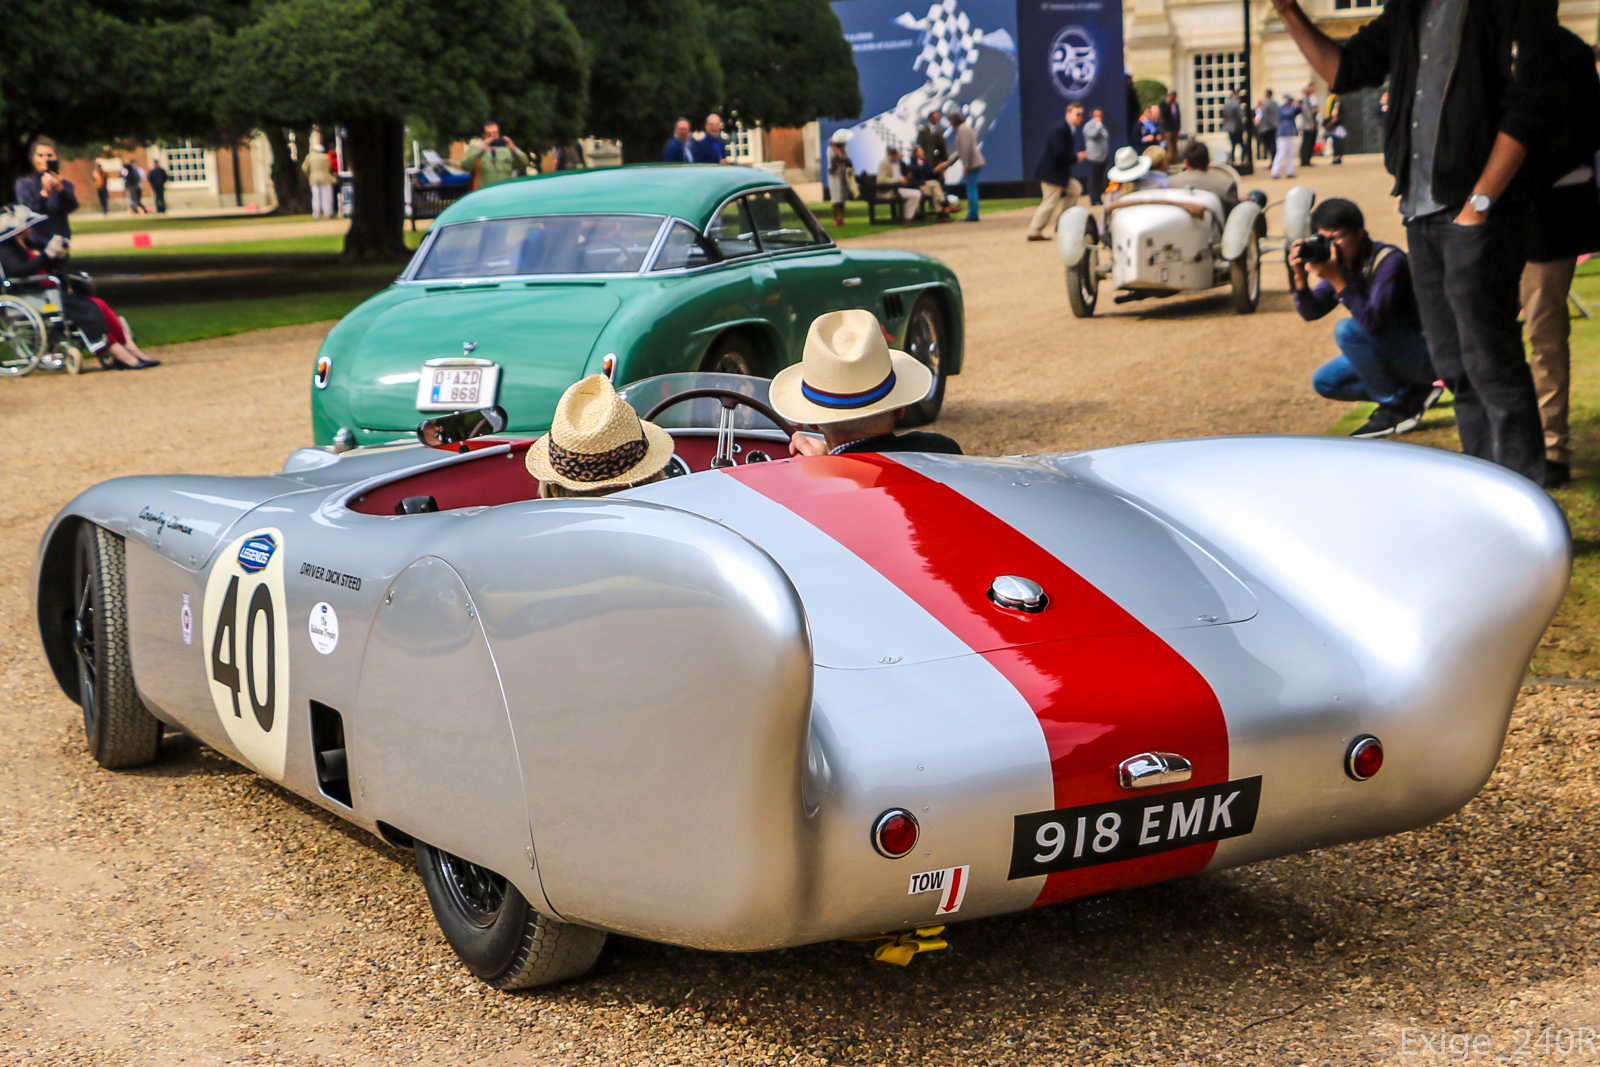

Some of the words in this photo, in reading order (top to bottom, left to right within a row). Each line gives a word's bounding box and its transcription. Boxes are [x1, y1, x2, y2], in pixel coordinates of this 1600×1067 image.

[452, 370, 479, 385] AZD
[450, 387, 478, 401] 868
[240, 547, 270, 564] LEGENDS
[325, 569, 341, 585] DICK
[341, 573, 362, 591] STEED
[212, 574, 276, 733] 40
[1033, 812, 1122, 864] 918
[1138, 790, 1241, 846] EMK
[912, 870, 945, 893] TOW
